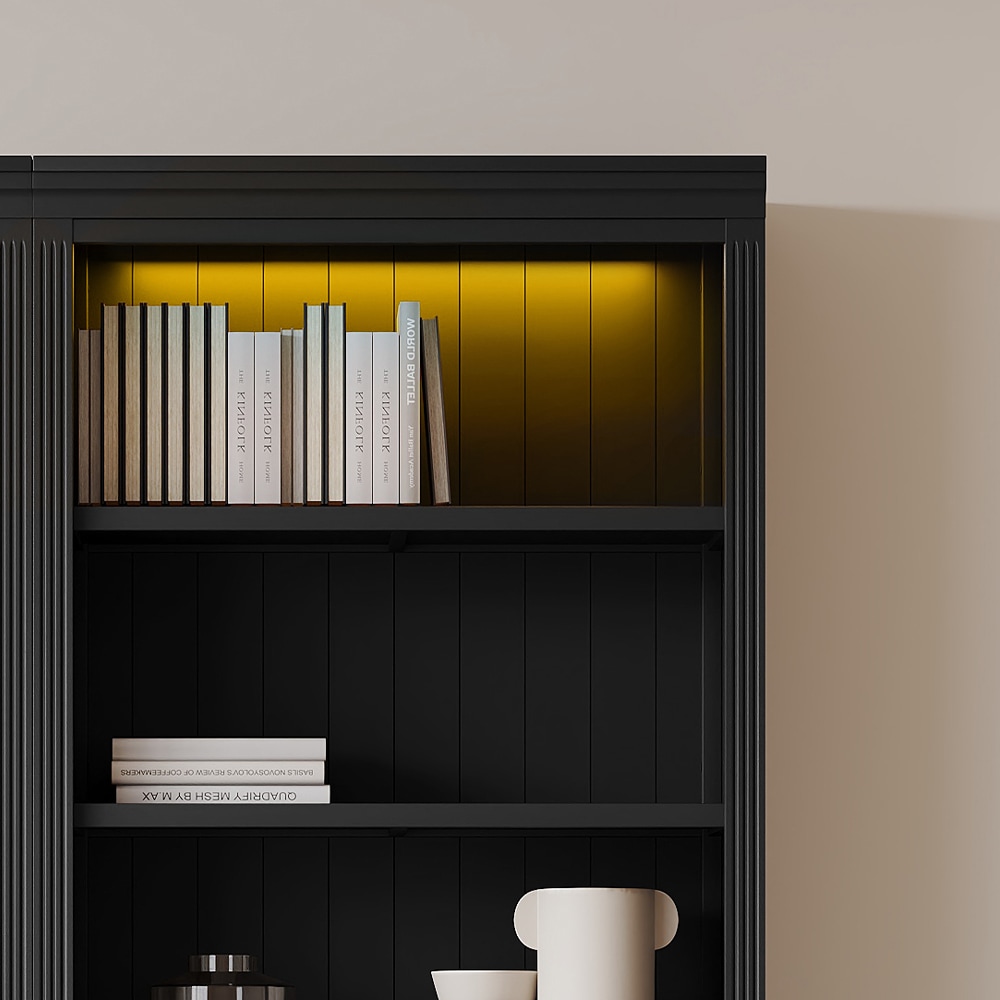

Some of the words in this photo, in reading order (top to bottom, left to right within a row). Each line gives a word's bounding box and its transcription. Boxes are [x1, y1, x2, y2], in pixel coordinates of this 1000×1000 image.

[142, 791, 172, 801] M.AX
[176, 791, 191, 801] BY
[195, 791, 230, 801] MESH
[233, 791, 296, 801] QUADRIFY
